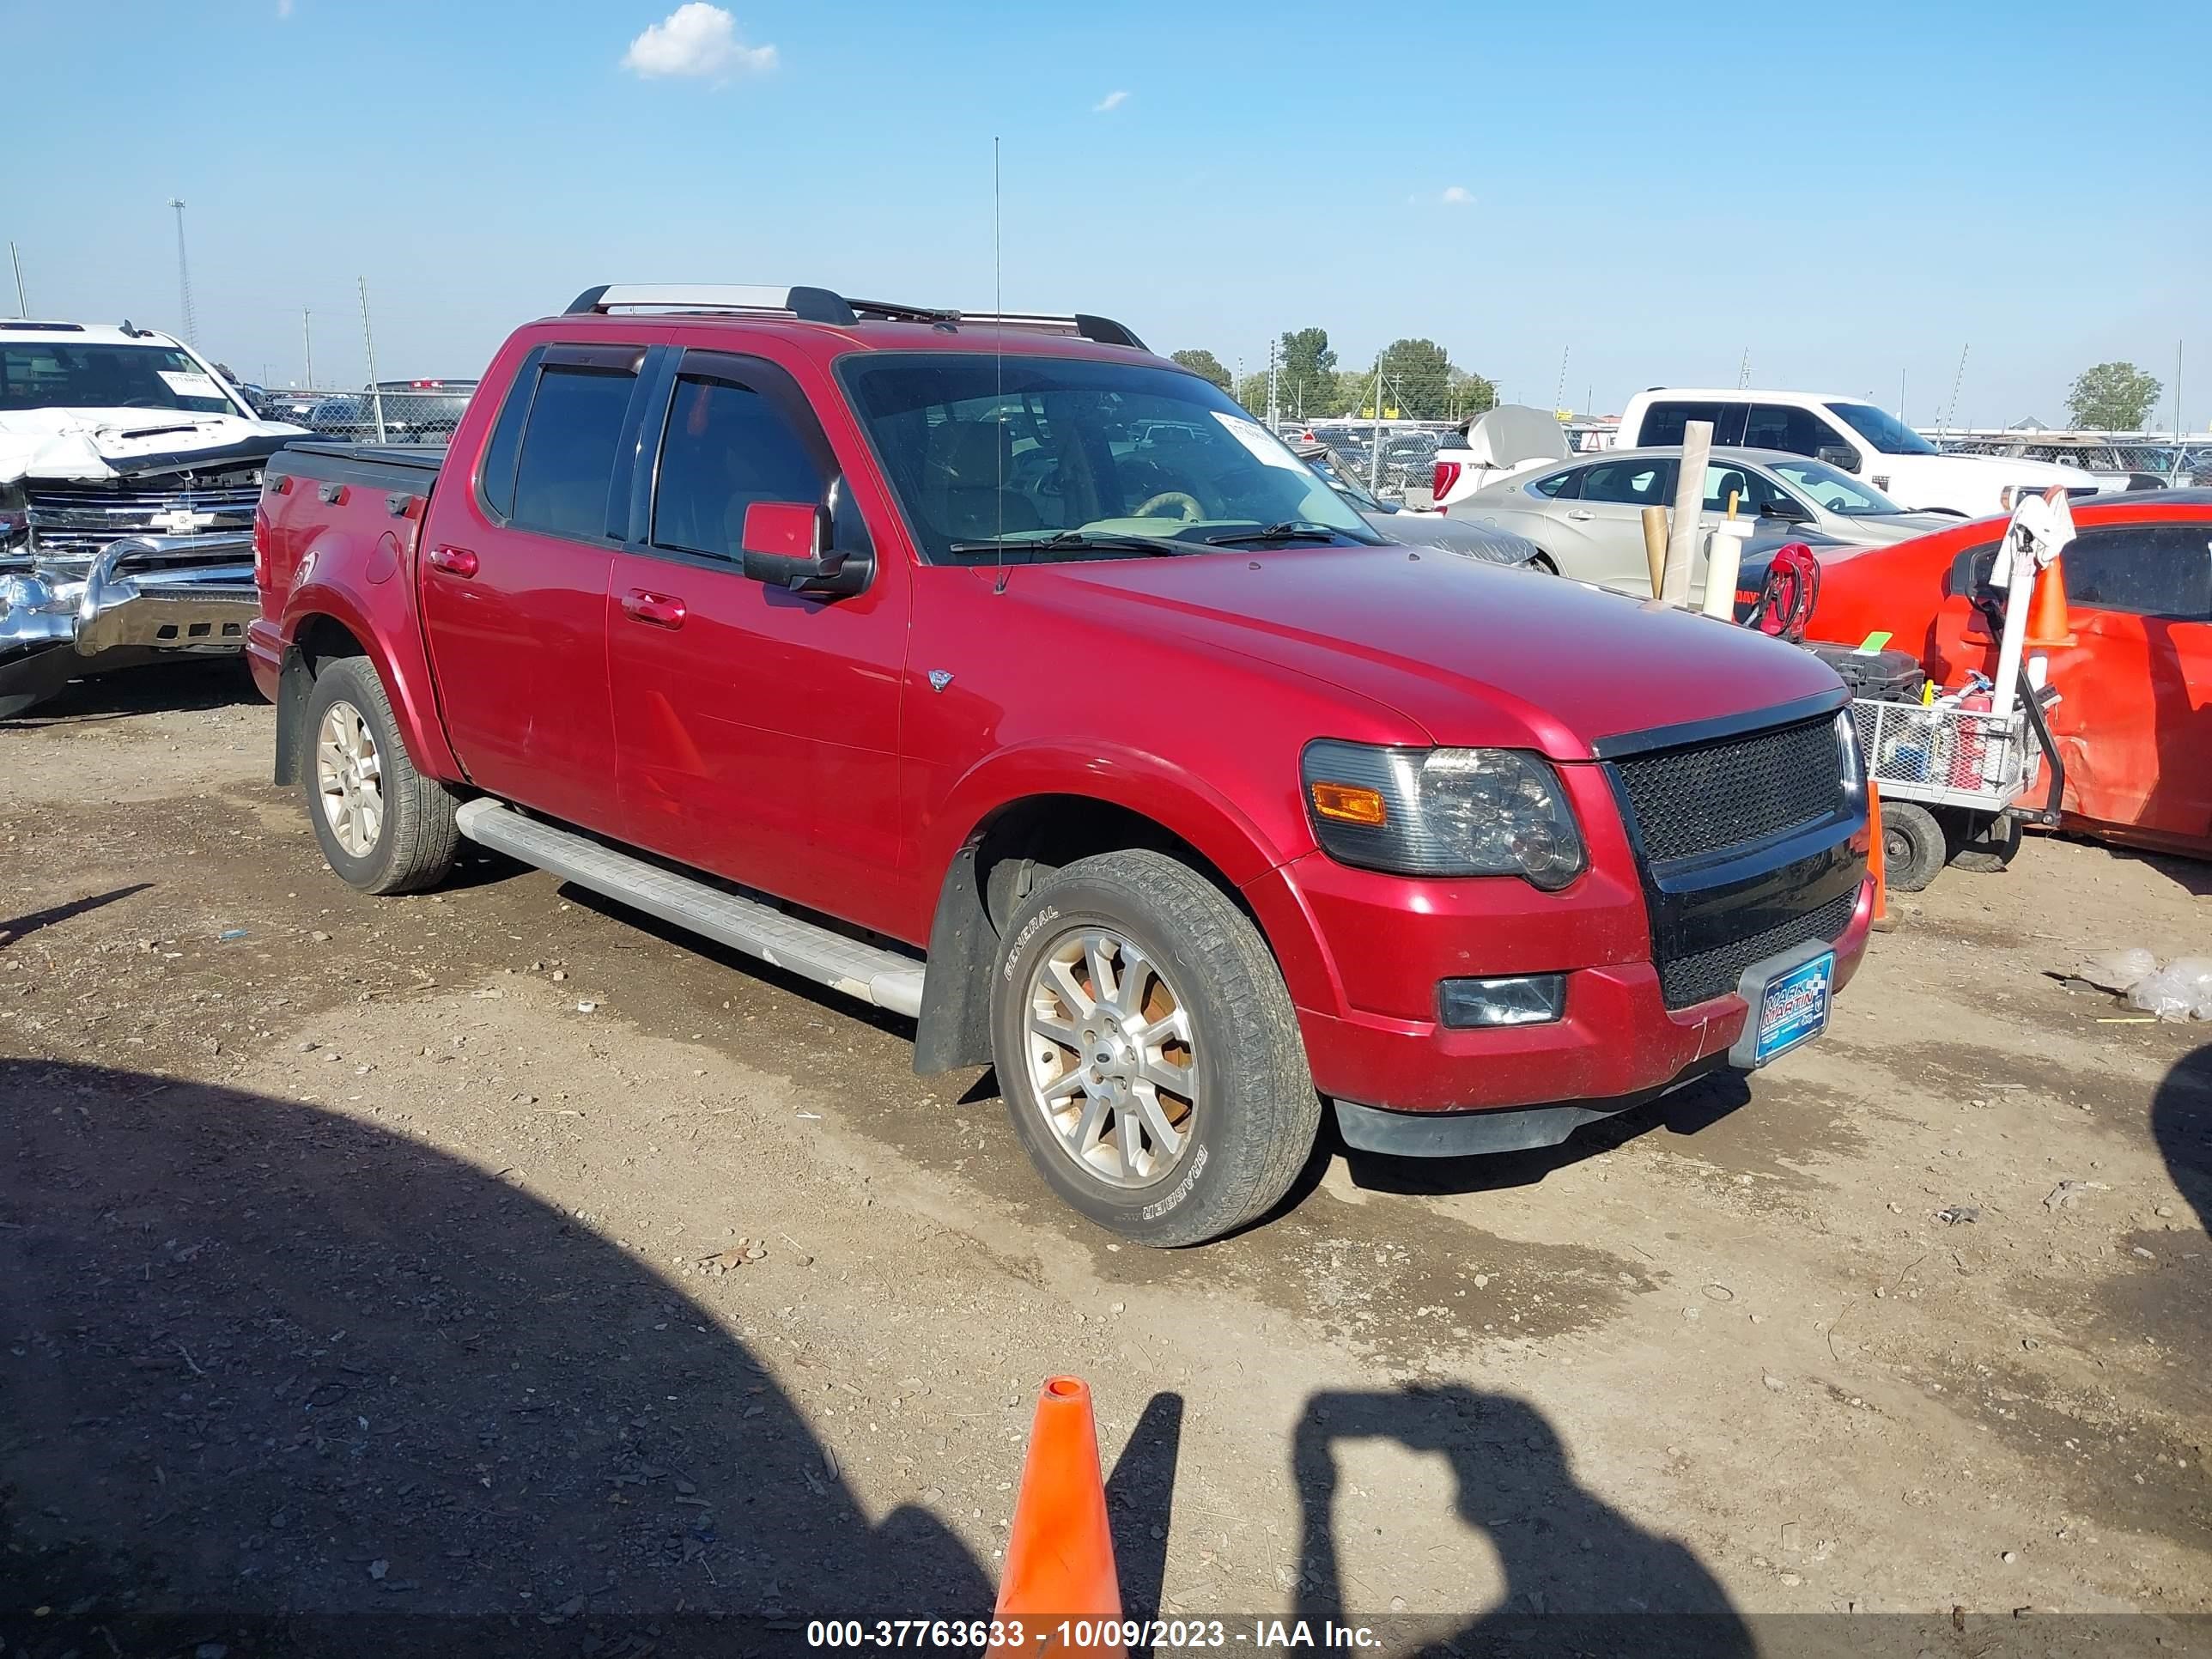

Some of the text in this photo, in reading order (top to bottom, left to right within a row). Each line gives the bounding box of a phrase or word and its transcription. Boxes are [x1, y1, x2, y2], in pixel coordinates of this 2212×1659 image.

[1003, 905, 1059, 981] GENERAL
[1763, 990, 1814, 1029] MARTIN
[1765, 978, 1808, 1012] MARK
[1142, 1144, 1208, 1220] GRABBER
